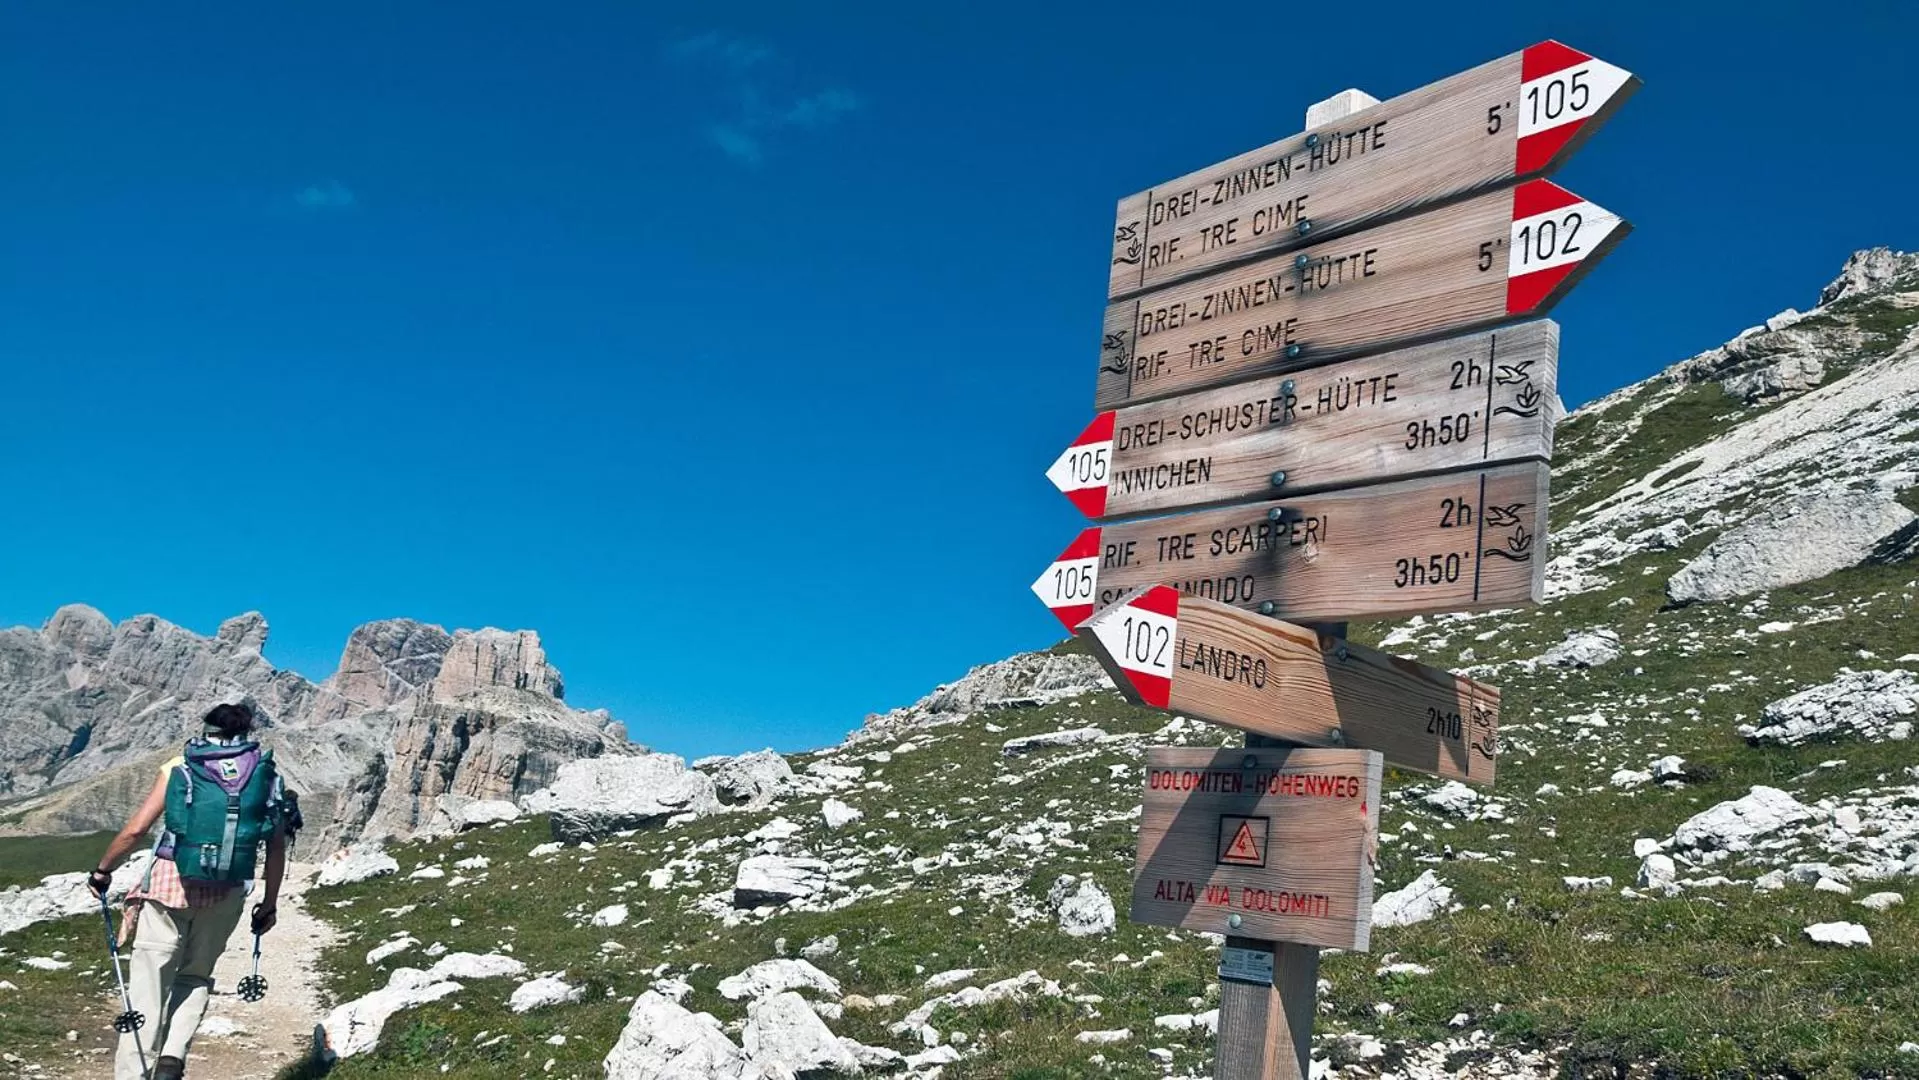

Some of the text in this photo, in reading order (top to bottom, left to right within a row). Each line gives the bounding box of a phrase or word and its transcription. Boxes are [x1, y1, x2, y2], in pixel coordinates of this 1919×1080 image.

[1487, 101, 1511, 135] 5'
[1527, 69, 1590, 125] 105
[1153, 121, 1386, 226] DREI-ZINNEN-HÜTTE
[1148, 195, 1309, 270] RIF. TRE CIME
[1478, 238, 1502, 272] 5'
[1519, 212, 1582, 265] 102
[1140, 248, 1377, 337] DREI-ZINNEN-HÜTTE
[1134, 317, 1299, 382] RIF. TRE CIME
[1449, 358, 1482, 392] 2h
[1119, 373, 1398, 451] DREI-SCHUSTER-HÜTTE
[1405, 411, 1480, 450] 3h50'
[1069, 448, 1107, 484] 105
[1113, 456, 1213, 497] INNICHEN
[1439, 499, 1473, 529] 2h
[1103, 515, 1327, 569] RIF. TRE SCARPERI
[1054, 564, 1093, 600] 105
[1394, 552, 1470, 589] 3h50'
[1122, 617, 1171, 669] 102
[1179, 638, 1269, 690] LANDRO
[1154, 879, 1331, 919] ALTA VIA DOLOMITI
